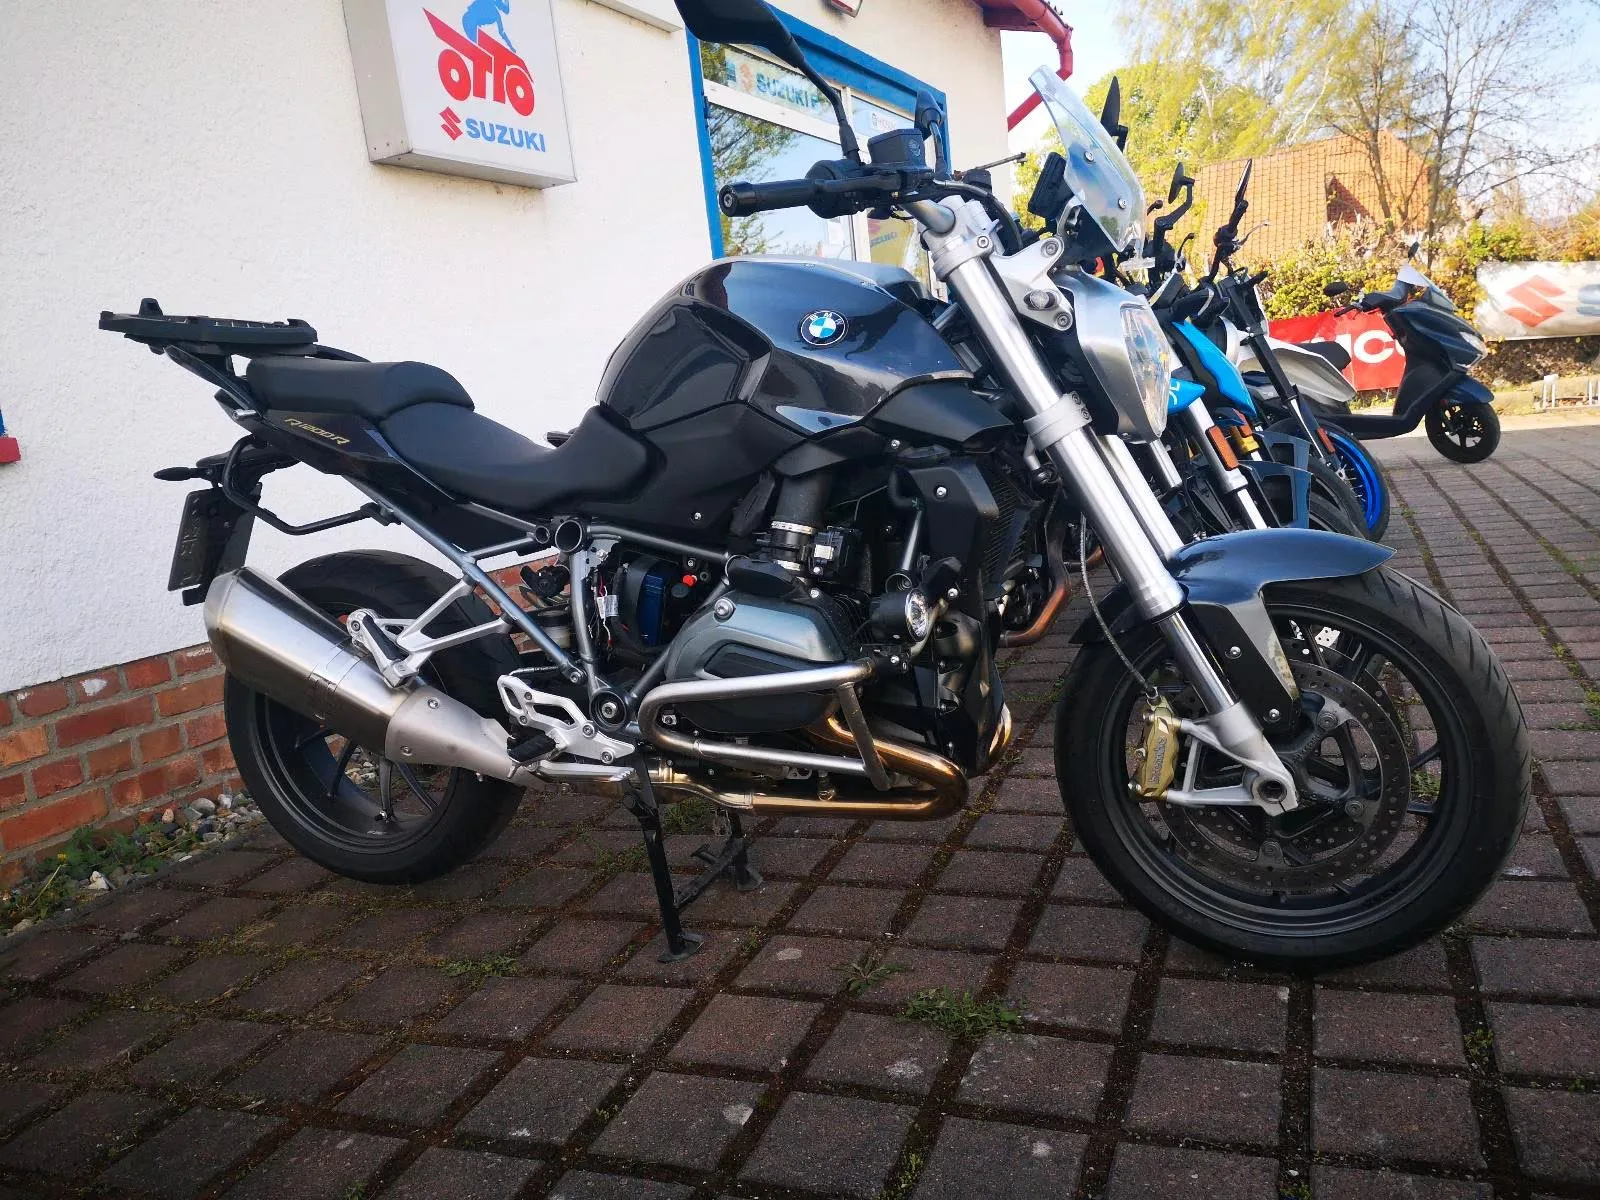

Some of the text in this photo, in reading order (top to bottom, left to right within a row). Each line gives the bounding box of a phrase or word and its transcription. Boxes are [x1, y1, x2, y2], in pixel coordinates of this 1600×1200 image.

[423, 8, 535, 117] OTTO
[465, 118, 546, 153] SUZUKI
[284, 418, 350, 445] R1200R
